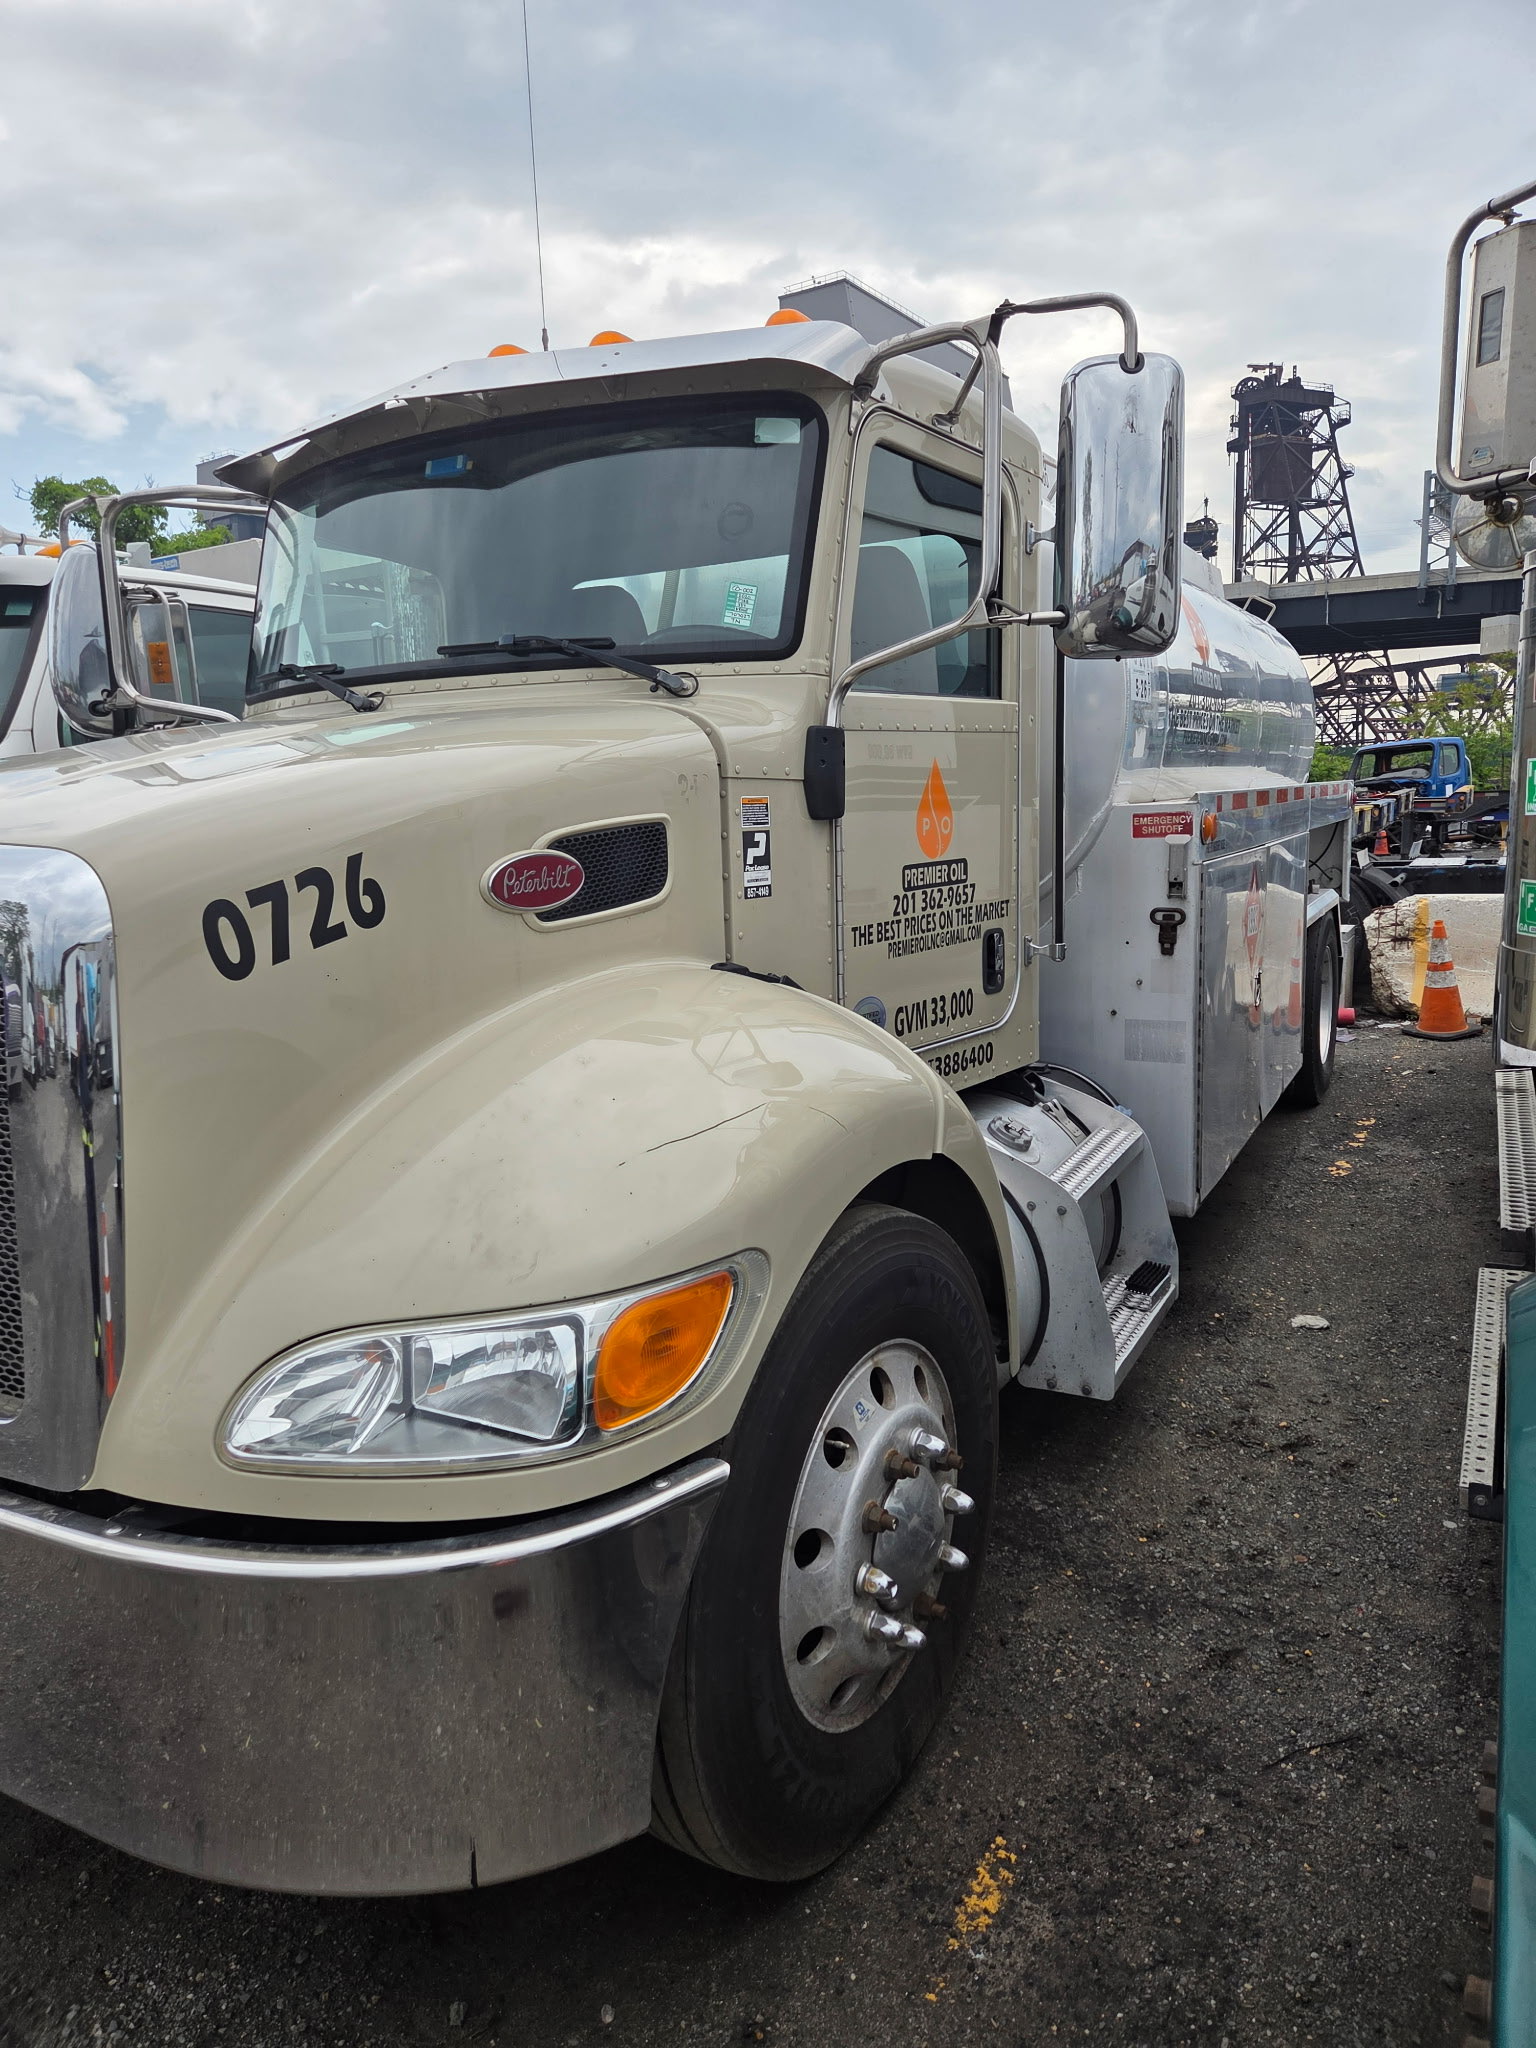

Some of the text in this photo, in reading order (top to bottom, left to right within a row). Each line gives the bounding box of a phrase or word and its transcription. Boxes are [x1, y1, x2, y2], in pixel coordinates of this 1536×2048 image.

[1134, 815, 1193, 826] EMERGENCY
[1142, 825, 1184, 834] SHUTOFF
[503, 864, 577, 899] Peterbilt
[904, 862, 967, 888] PREMIER OIL
[202, 852, 386, 981] 0726
[893, 883, 976, 917] 201 362-9657
[851, 900, 1010, 947] THE BEST PRICES ON THE MARKET
[894, 988, 974, 1037] GVM 33,000
